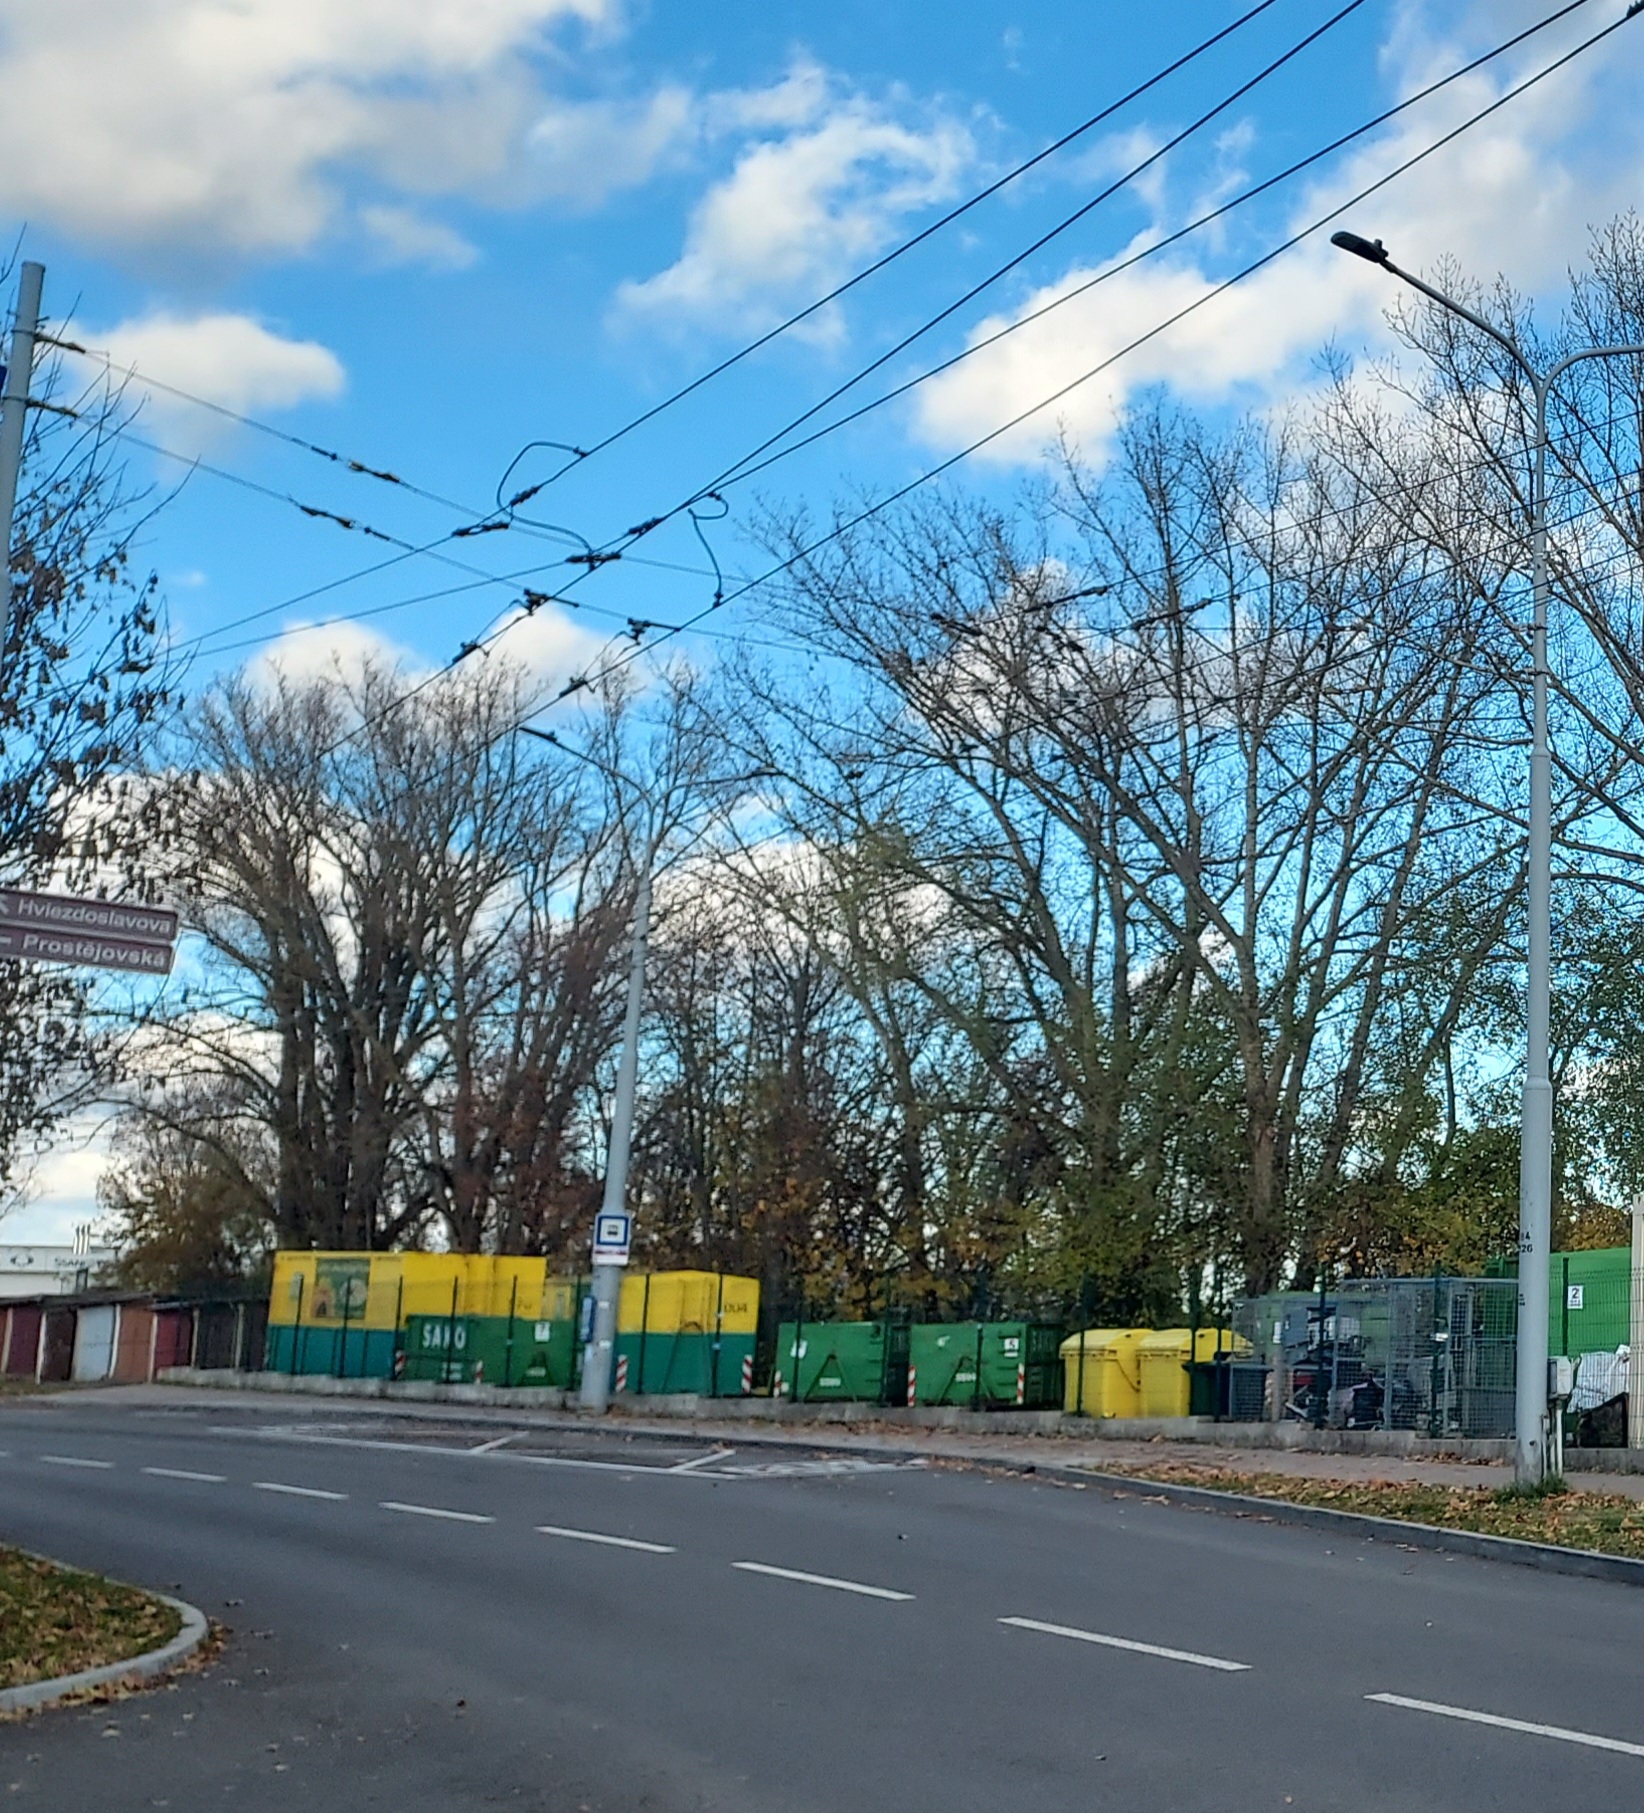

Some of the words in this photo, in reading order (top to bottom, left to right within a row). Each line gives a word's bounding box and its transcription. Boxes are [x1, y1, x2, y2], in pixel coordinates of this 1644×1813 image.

[17, 898, 171, 934] Hviezdoslavova
[22, 933, 166, 968] Prostějovská
[1571, 1287, 1580, 1299] 2
